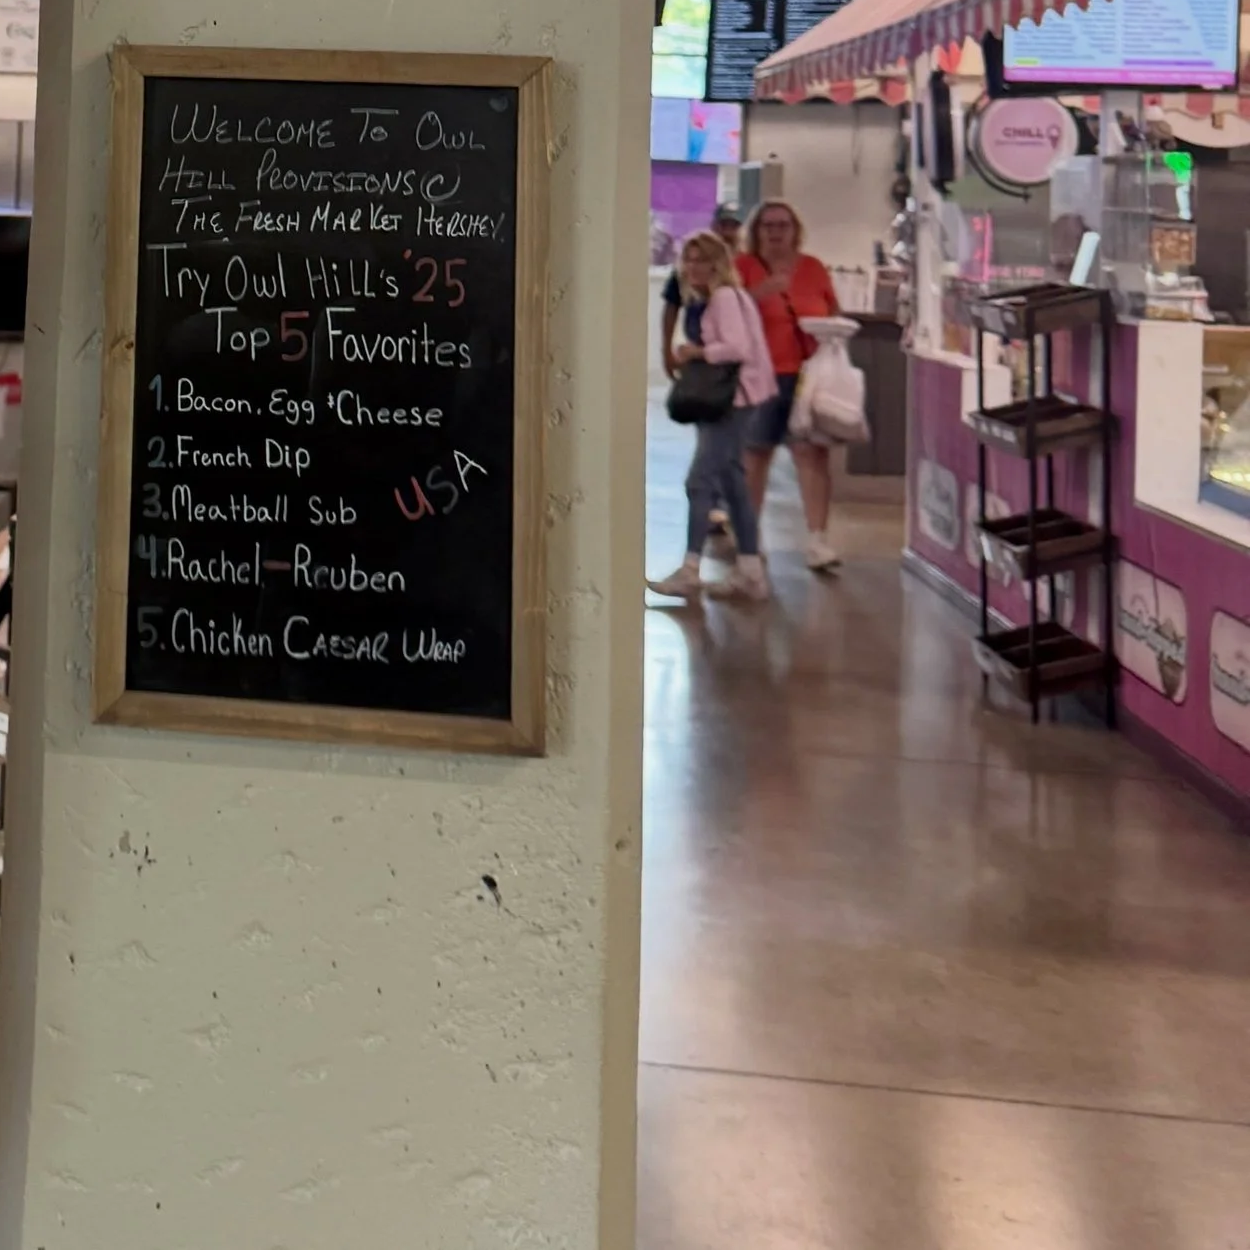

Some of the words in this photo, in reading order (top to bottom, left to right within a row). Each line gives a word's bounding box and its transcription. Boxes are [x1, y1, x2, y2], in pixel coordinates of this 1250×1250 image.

[171, 103, 337, 148] WELCOME
[351, 107, 399, 142] TO
[415, 111, 485, 150] OWL
[159, 156, 236, 191] HILL
[256, 148, 416, 196] PROVISIONS
[171, 196, 223, 233] THE
[235, 200, 299, 232] FRESH
[146, 242, 210, 306] Try
[226, 252, 286, 300] Owl
[205, 307, 270, 361] Top
[280, 311, 309, 361] 5
[326, 307, 472, 368] Favorites
[269, 389, 315, 424] Egg
[337, 390, 443, 426] Cheese
[177, 435, 251, 467] French
[265, 438, 310, 477] Dip
[172, 484, 287, 522] Meatball
[309, 497, 356, 524] Sub
[394, 450, 487, 520] USA
[137, 607, 165, 650] 5.
[172, 608, 272, 657] Chicken
[283, 616, 390, 663] CAESAR
[403, 628, 466, 662] WRAP
